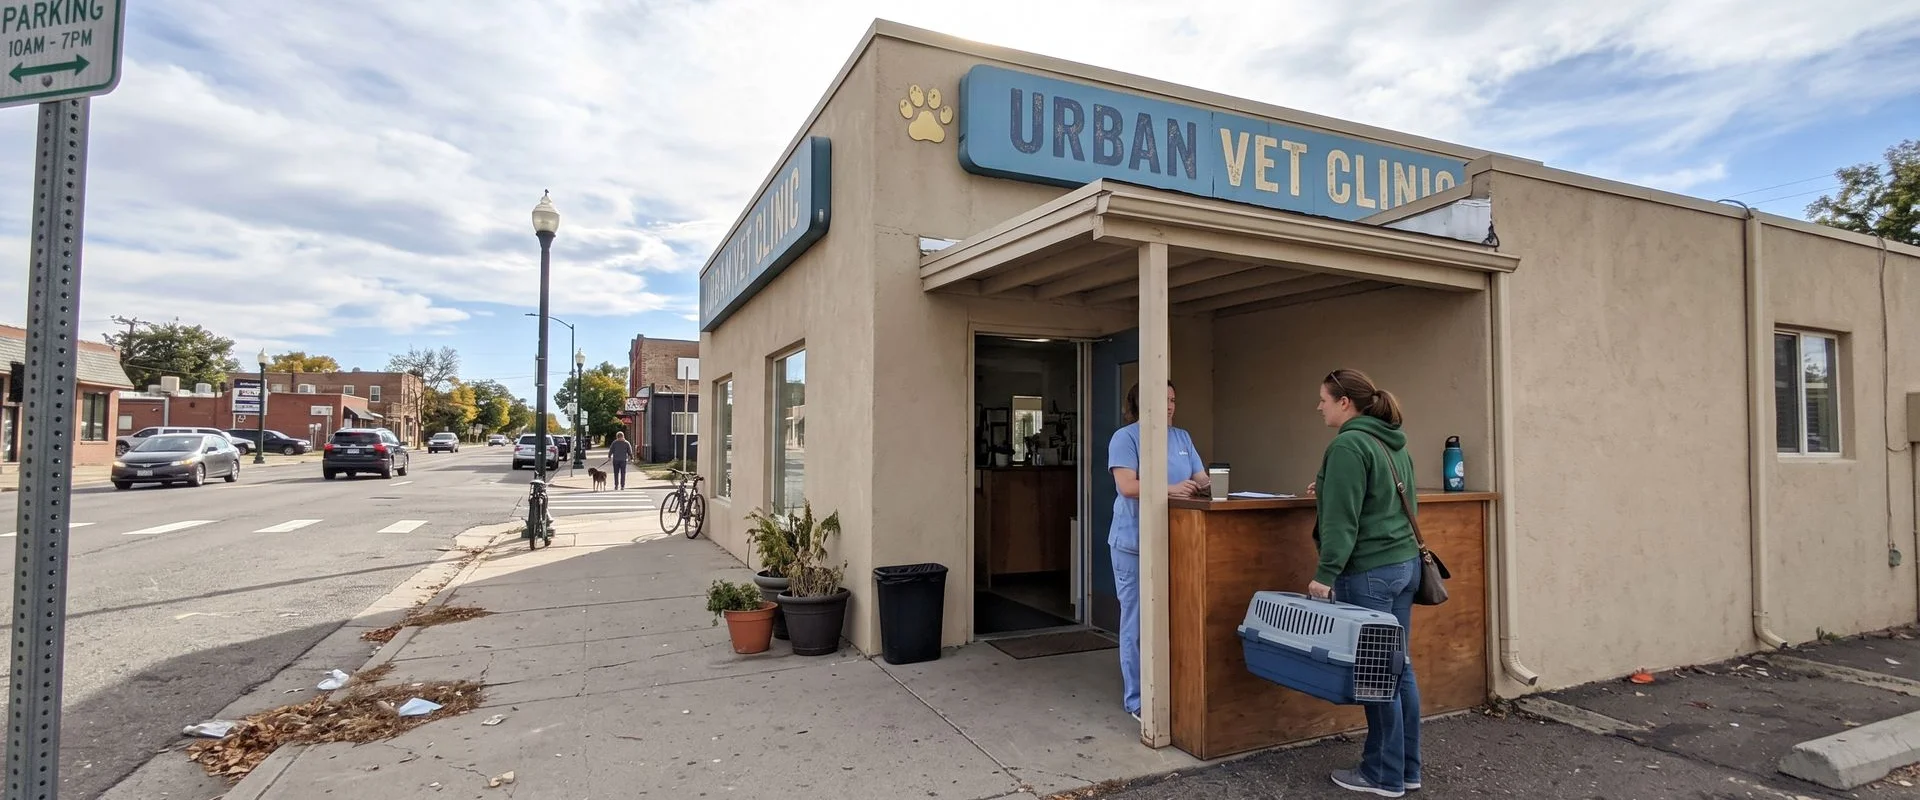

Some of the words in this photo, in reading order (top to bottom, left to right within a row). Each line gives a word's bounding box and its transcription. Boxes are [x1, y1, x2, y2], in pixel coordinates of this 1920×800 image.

[2, 0, 104, 34] PARKING
[9, 36, 45, 57] 10AM
[62, 28, 93, 49] 7PM
[1010, 87, 1197, 180] URBAN
[1220, 128, 1307, 197] VET
[733, 224, 752, 287] VET
[755, 167, 799, 265] CLINIC
